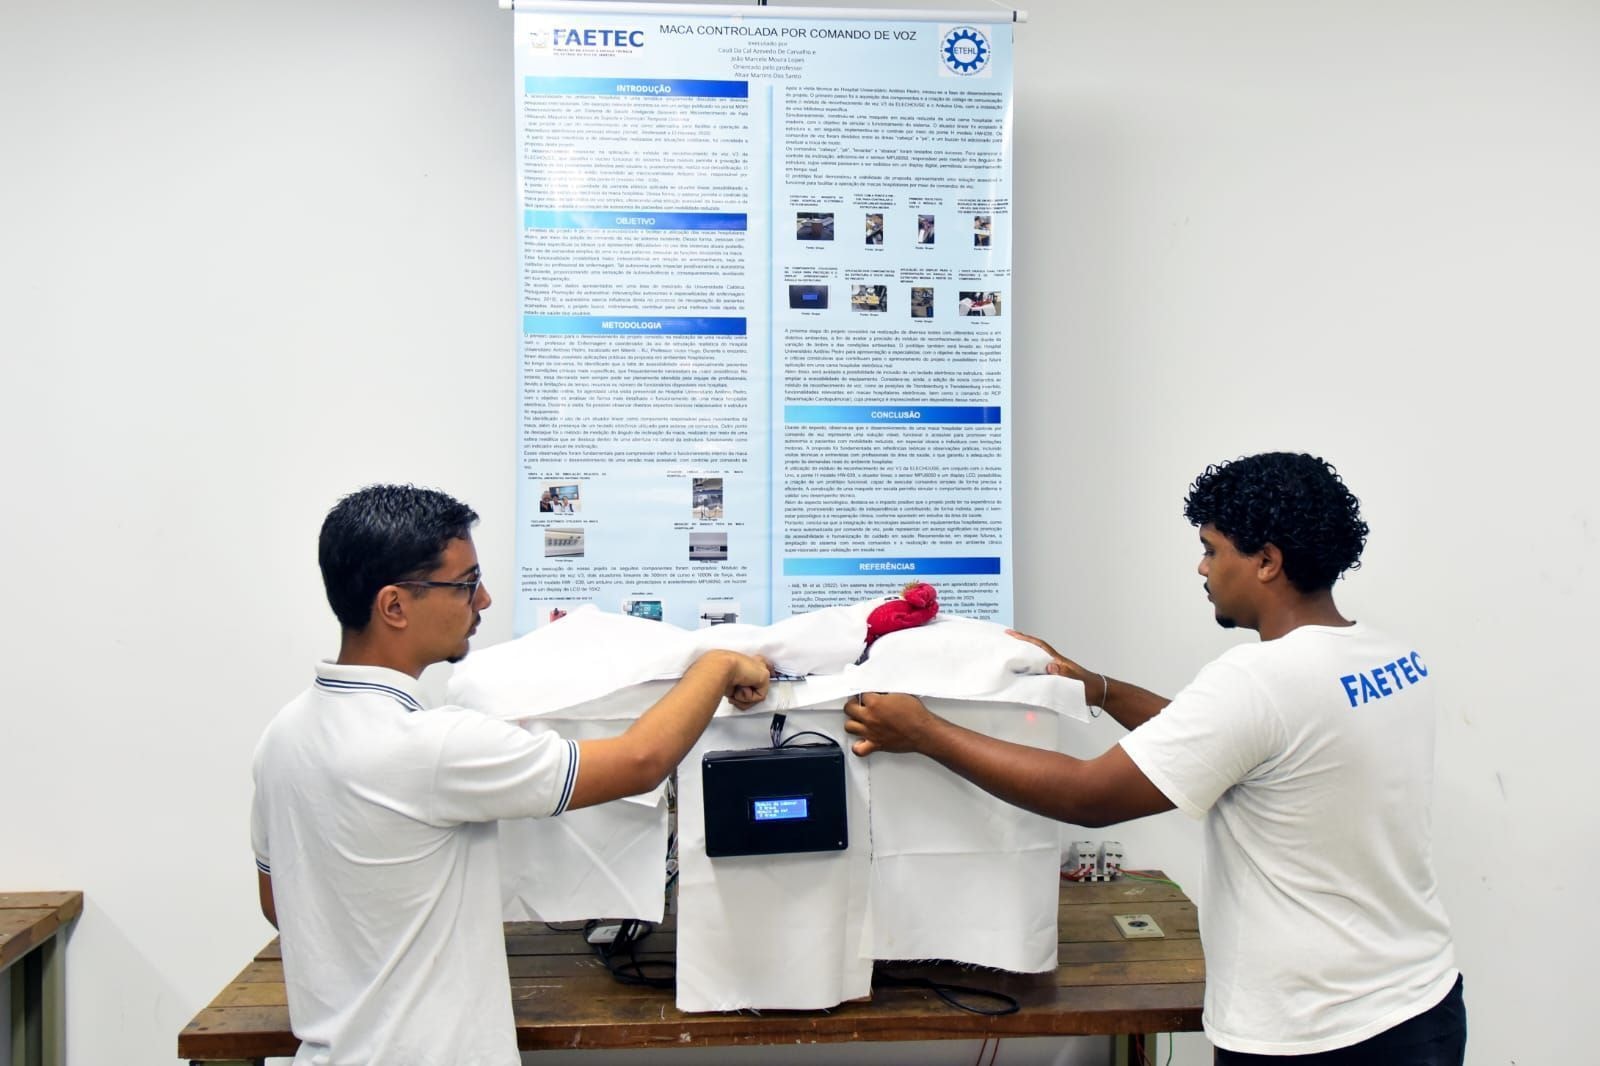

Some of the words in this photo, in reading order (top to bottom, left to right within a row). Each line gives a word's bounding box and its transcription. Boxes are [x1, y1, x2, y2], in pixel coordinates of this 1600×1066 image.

[553, 28, 644, 48] FAETEC
[659, 25, 694, 35] MACA
[697, 25, 778, 37] CONTROLADA
[781, 28, 807, 38] POR
[810, 29, 871, 40] COMANDO
[874, 30, 890, 40] DE
[893, 31, 917, 41] VOZ
[953, 46, 977, 55] ETEHL
[616, 83, 672, 95] INTRODUÇÃO
[615, 217, 656, 226] OBJETIVO
[601, 320, 662, 330] METODOLOGIA
[870, 409, 921, 420] CONCLUSÃO
[859, 561, 916, 571] REFERÊNCIAS
[1340, 651, 1428, 708] FAETEC
